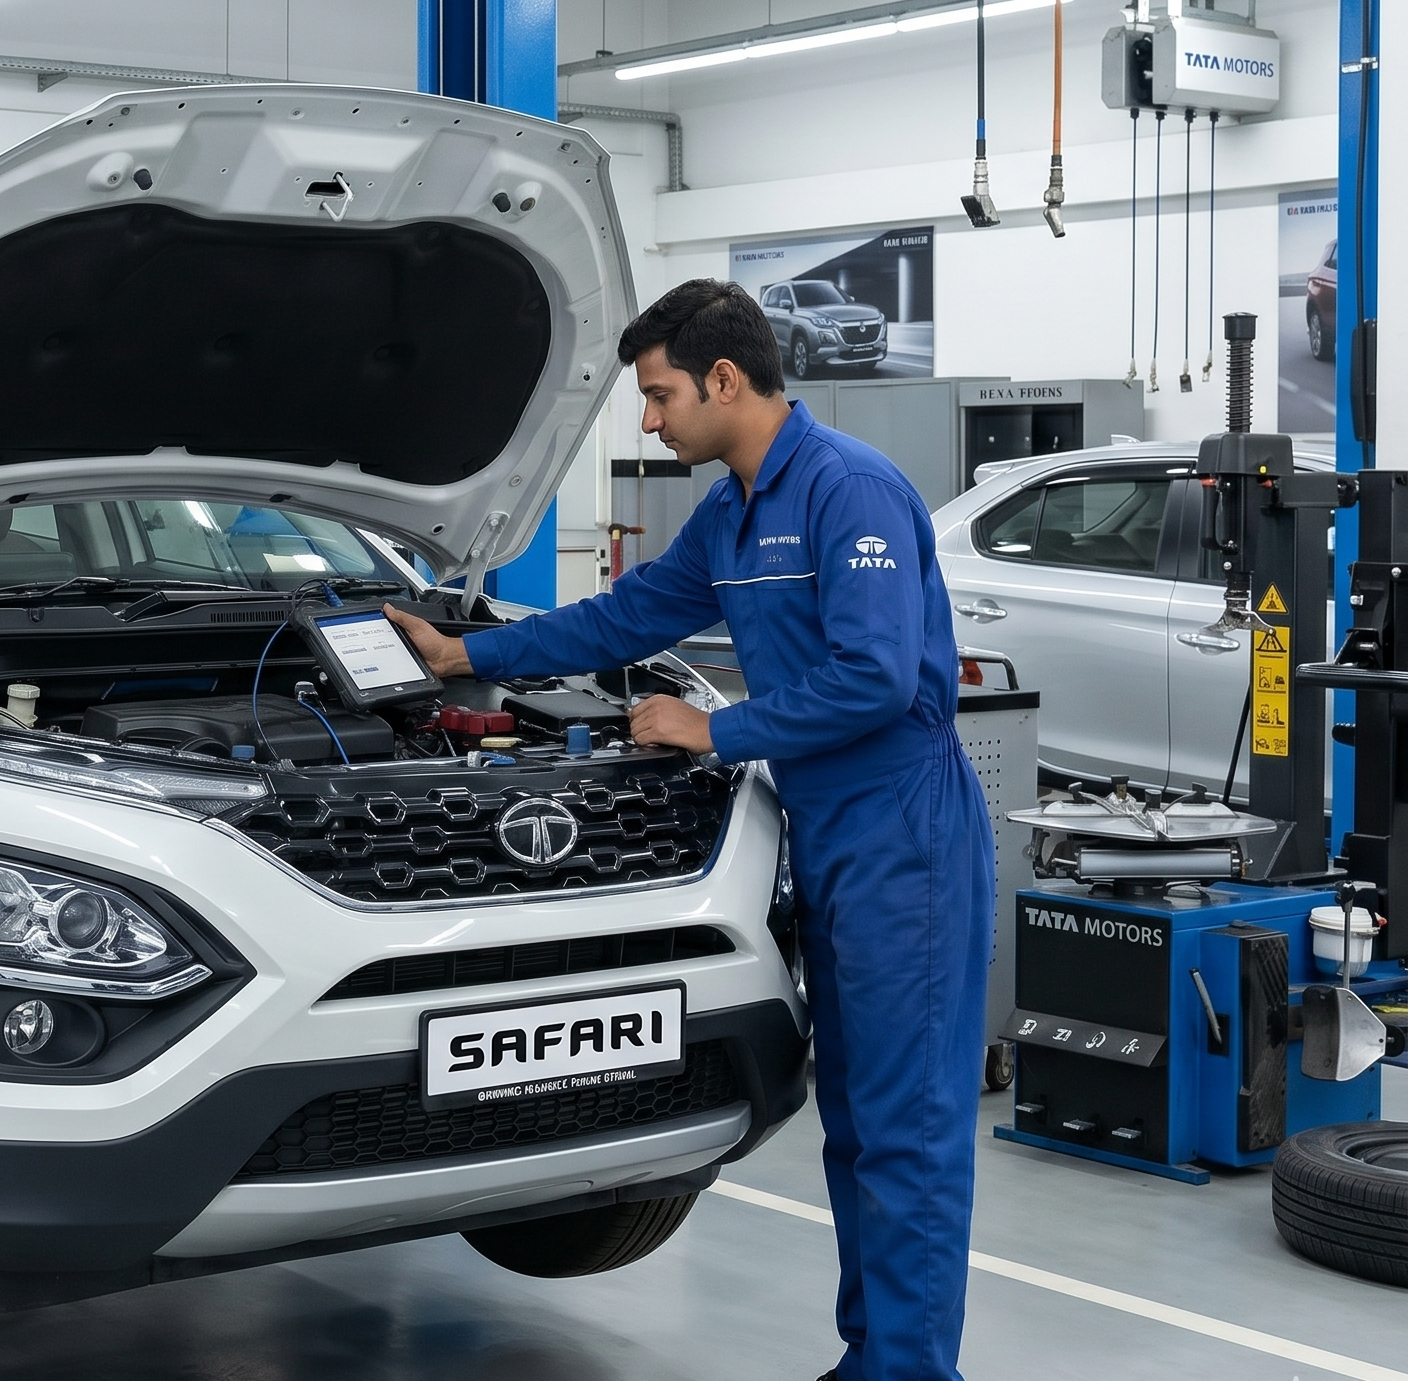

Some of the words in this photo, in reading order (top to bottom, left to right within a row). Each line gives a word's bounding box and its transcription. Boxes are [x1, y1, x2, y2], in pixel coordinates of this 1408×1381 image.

[1184, 52, 1220, 70] TATA
[1223, 57, 1274, 78] MOTORS
[848, 557, 897, 570] TATA
[1025, 907, 1079, 933] TATA
[1084, 917, 1163, 947] MOTORS
[448, 1010, 662, 1073] SAFARI
